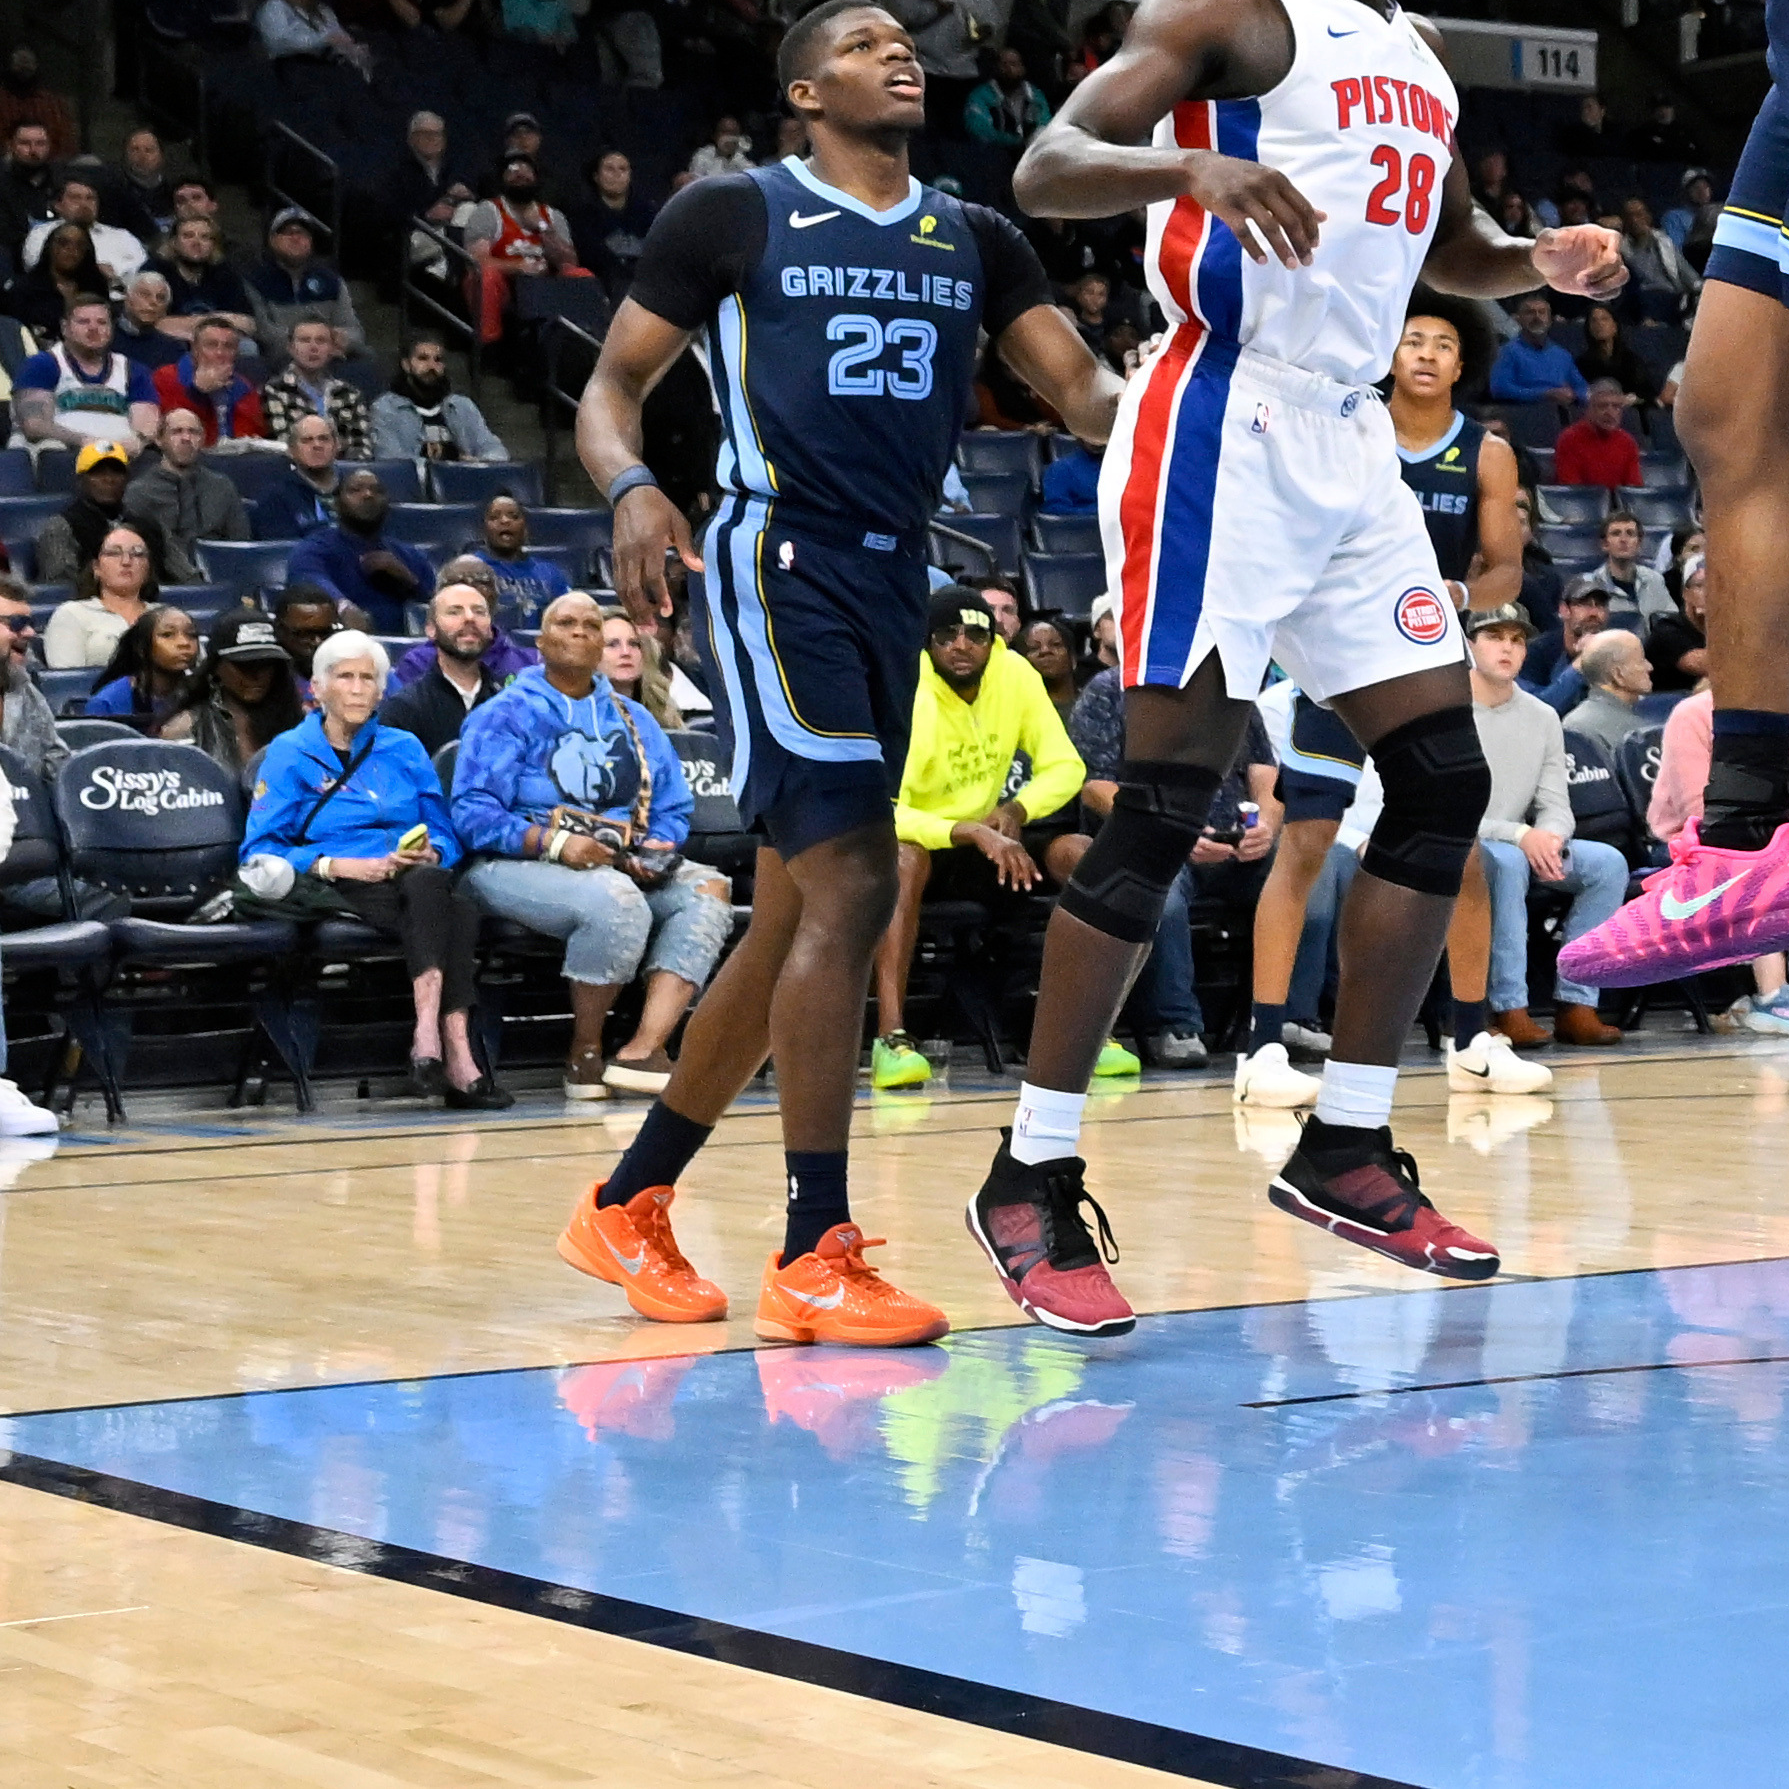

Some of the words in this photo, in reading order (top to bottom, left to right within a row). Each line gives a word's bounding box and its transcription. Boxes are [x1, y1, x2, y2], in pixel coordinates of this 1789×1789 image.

[1538, 47, 1580, 78] 114
[1364, 143, 1436, 236] 28
[780, 266, 974, 312] GRIZZLIES
[825, 313, 939, 401] 23
[80, 766, 181, 811] Sissy's
[120, 790, 161, 816] Log
[160, 787, 226, 812] Cabin
